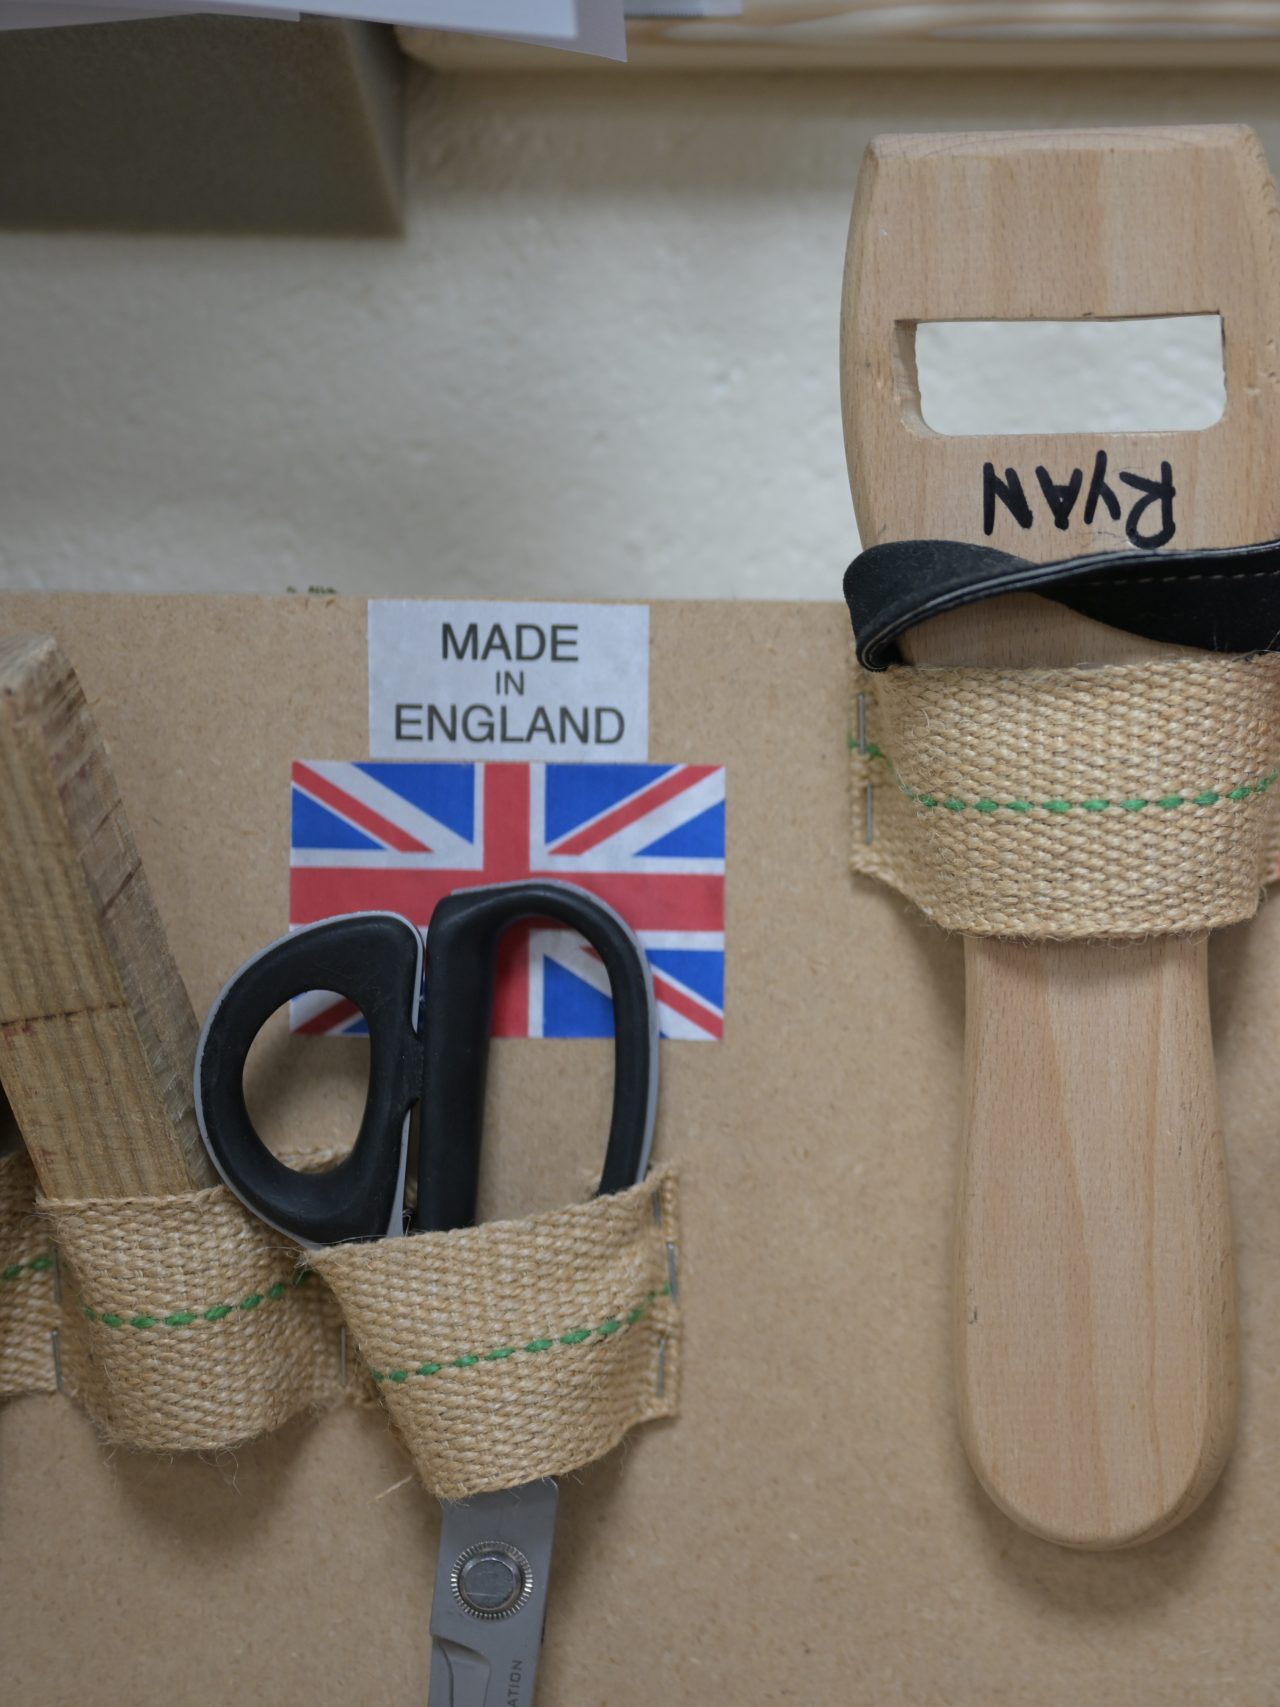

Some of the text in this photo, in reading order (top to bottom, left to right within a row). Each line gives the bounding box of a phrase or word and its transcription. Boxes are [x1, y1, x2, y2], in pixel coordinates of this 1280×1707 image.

[441, 622, 579, 663] MADE
[495, 670, 525, 696] IN
[394, 703, 626, 745] ENGLAND
